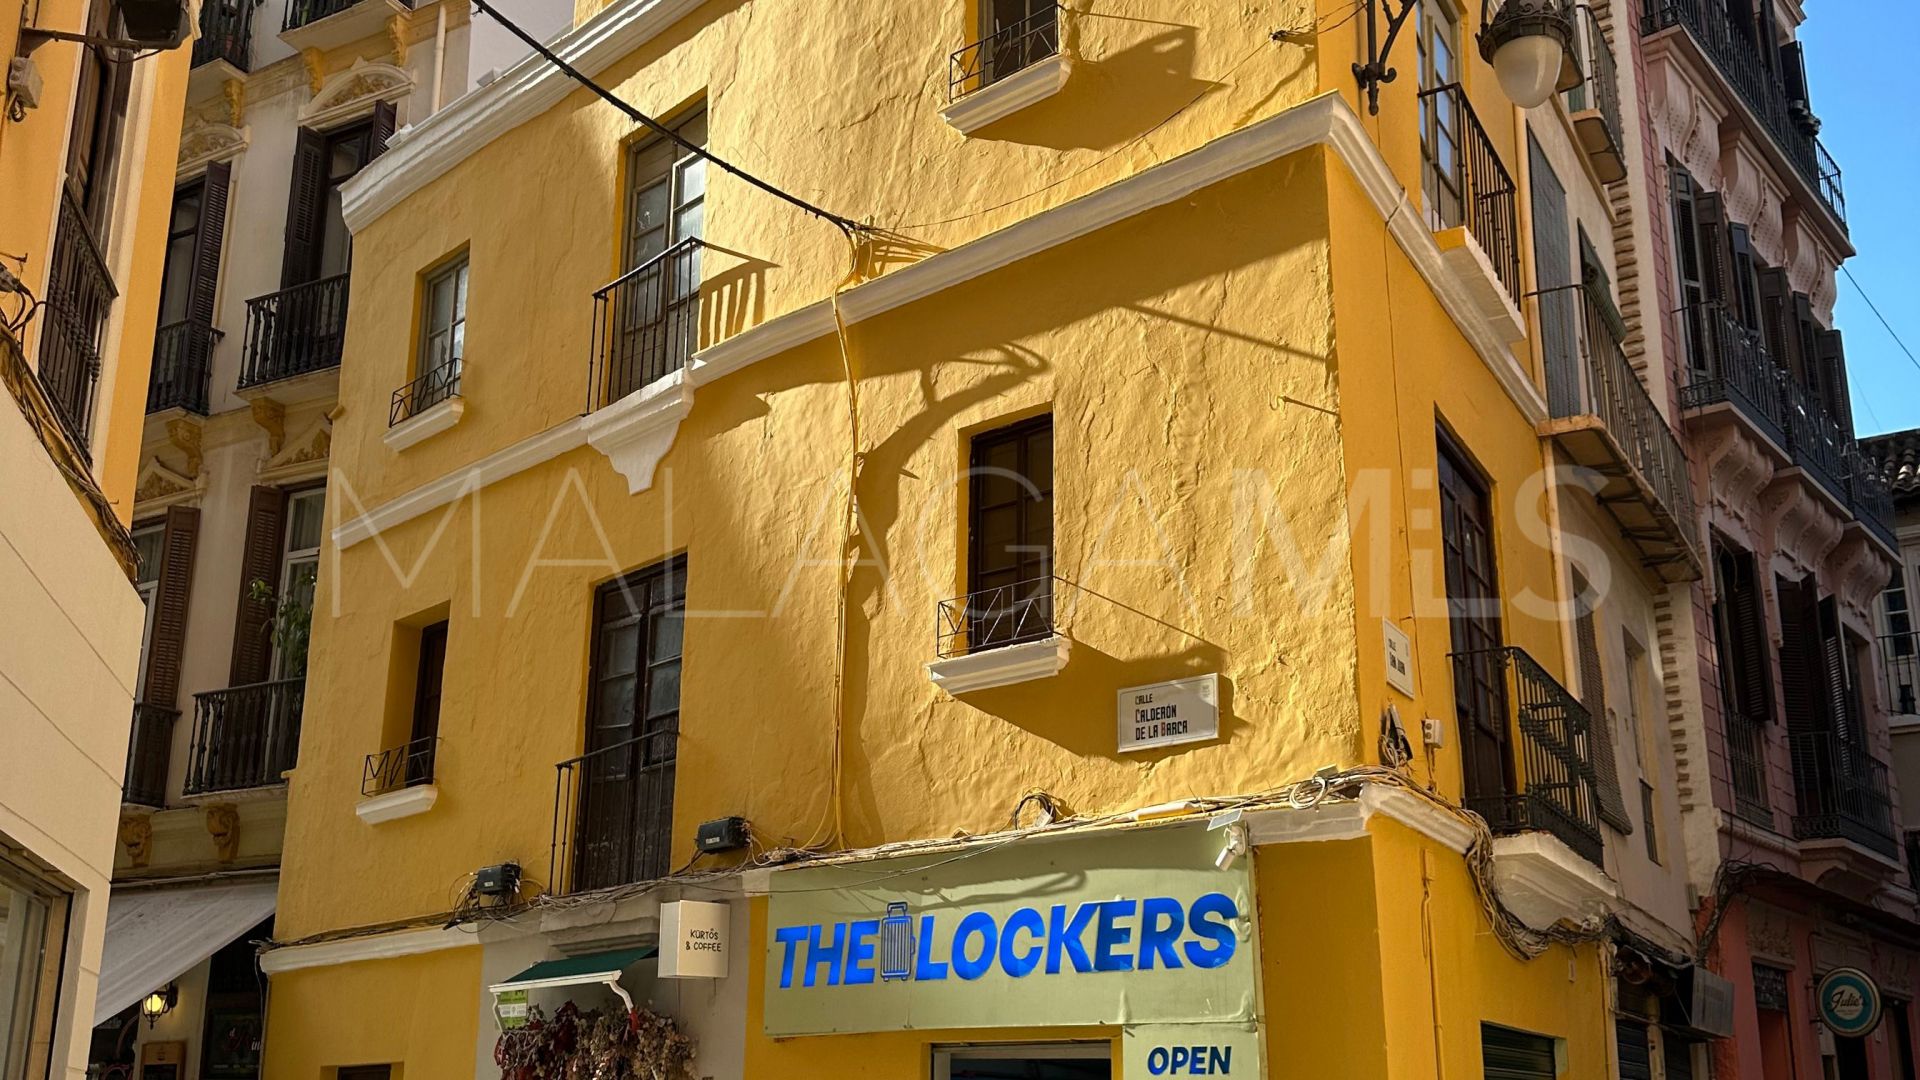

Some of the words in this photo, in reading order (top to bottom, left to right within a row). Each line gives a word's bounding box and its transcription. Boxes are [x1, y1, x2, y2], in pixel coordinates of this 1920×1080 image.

[1135, 693, 1153, 705] CALLE
[1135, 704, 1177, 723] CALDERÓN
[1135, 726, 1145, 740] DE
[1148, 724, 1158, 738] LA
[1161, 720, 1188, 736] BARCA
[685, 941, 691, 951] &
[693, 941, 722, 952] COFFEE
[776, 919, 880, 989] THE
[914, 893, 1239, 982] LOCKERS
[1147, 1045, 1232, 1076] OPEN
